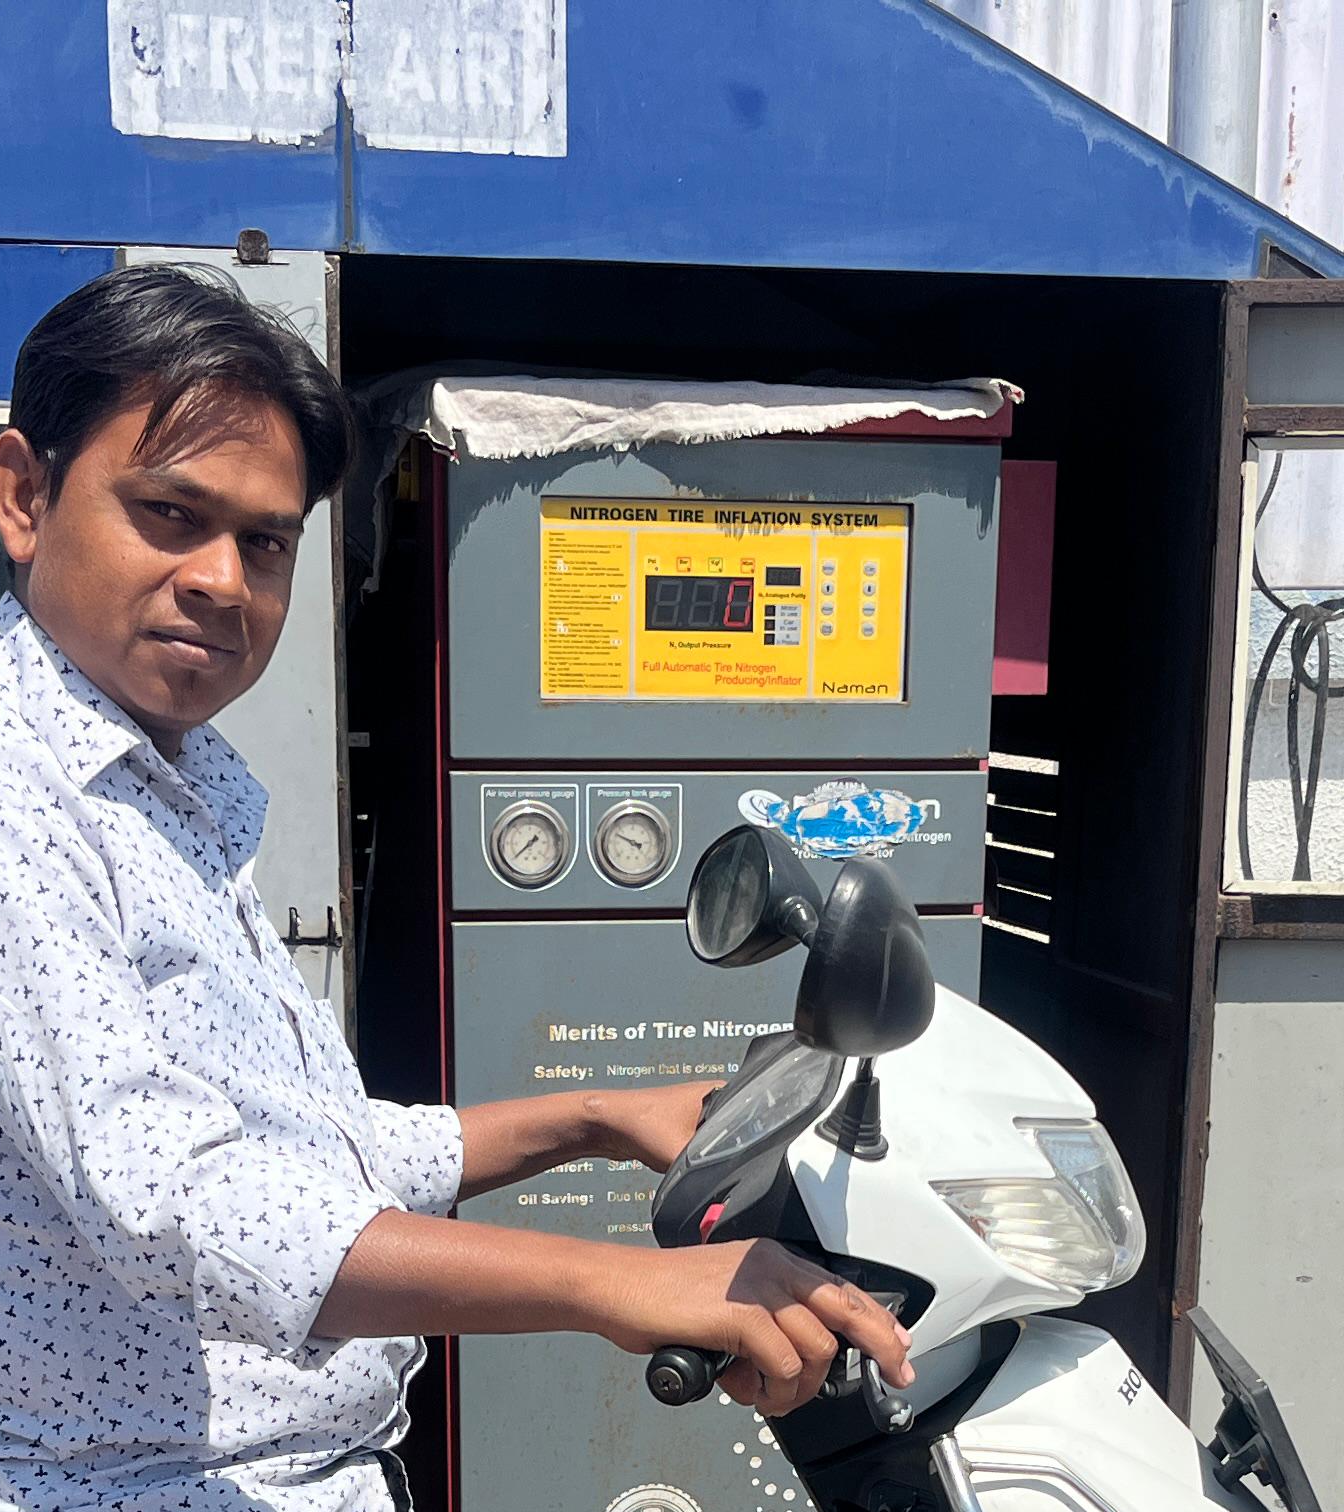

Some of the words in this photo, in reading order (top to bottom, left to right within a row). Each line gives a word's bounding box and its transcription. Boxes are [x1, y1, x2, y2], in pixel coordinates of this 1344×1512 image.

[386, 28, 516, 108] AIR
[570, 506, 657, 521] NITROGEN
[668, 508, 704, 523] TIRE
[714, 510, 801, 525] INFLATION
[811, 512, 878, 527] SYSTEM
[678, 641, 700, 650] Output
[702, 641, 732, 649] Pressure
[642, 661, 661, 672] Full
[662, 661, 711, 673] Automatic
[714, 662, 733, 673] Tire
[735, 662, 776, 675] Nitrogen
[714, 674, 803, 688] Producing/Inflator
[822, 681, 889, 694] Naman
[485, 789, 497, 798] Air
[498, 789, 517, 799] input
[518, 790, 550, 799] pressure
[551, 790, 575, 799] gauge
[597, 789, 630, 798] Pressure
[631, 789, 648, 798] tank
[649, 790, 672, 799] gauge
[549, 1024, 618, 1042] Merits
[623, 1023, 648, 1040] of
[653, 1022, 697, 1039] Tire
[703, 1020, 794, 1038] Nitrogen
[534, 1064, 594, 1081] Safety:
[606, 1064, 655, 1078] Nitrogen
[658, 1063, 679, 1075] that
[682, 1063, 692, 1074] is
[694, 1063, 725, 1074] close
[727, 1063, 739, 1073] to
[518, 1194, 537, 1206] Oil
[541, 1192, 594, 1207] Saving:
[607, 1191, 631, 1202] Due
[634, 1191, 646, 1201] to
